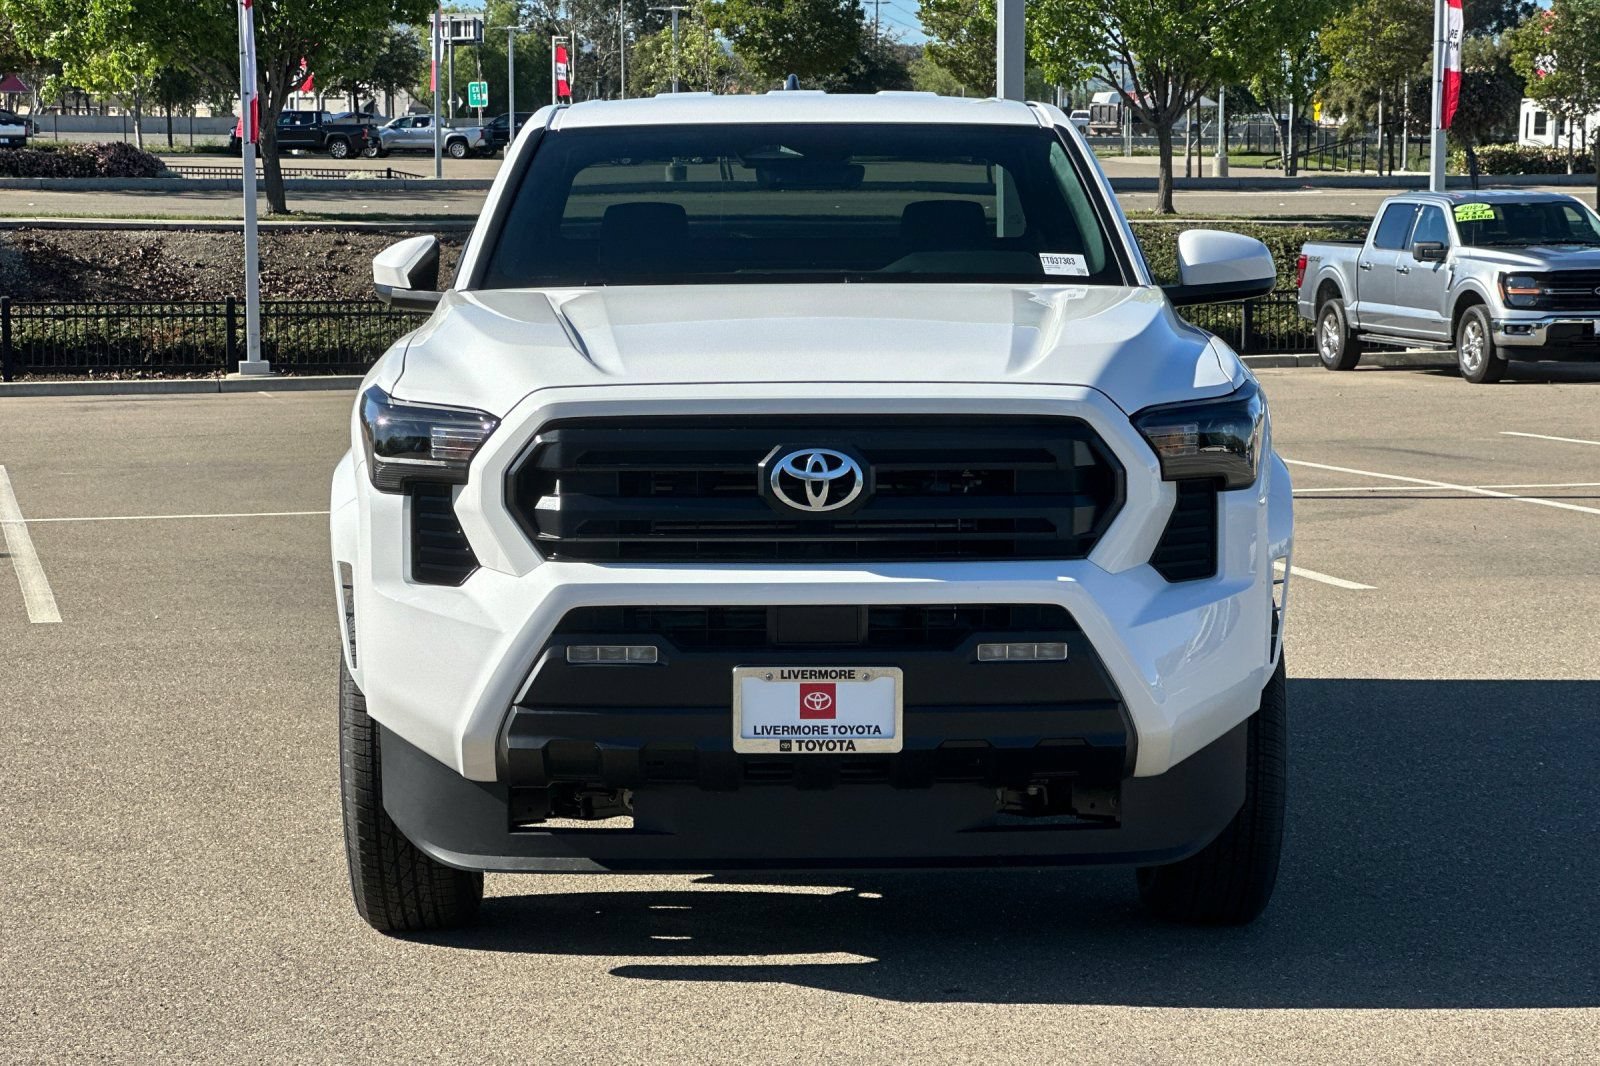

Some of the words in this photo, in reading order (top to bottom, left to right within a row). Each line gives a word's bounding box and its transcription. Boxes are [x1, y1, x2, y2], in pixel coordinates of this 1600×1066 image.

[780, 669, 856, 680] LIVERMORE
[753, 725, 829, 736] LIVERMORE
[832, 725, 882, 735] TOYOTA
[796, 739, 856, 752] TOYOTA
